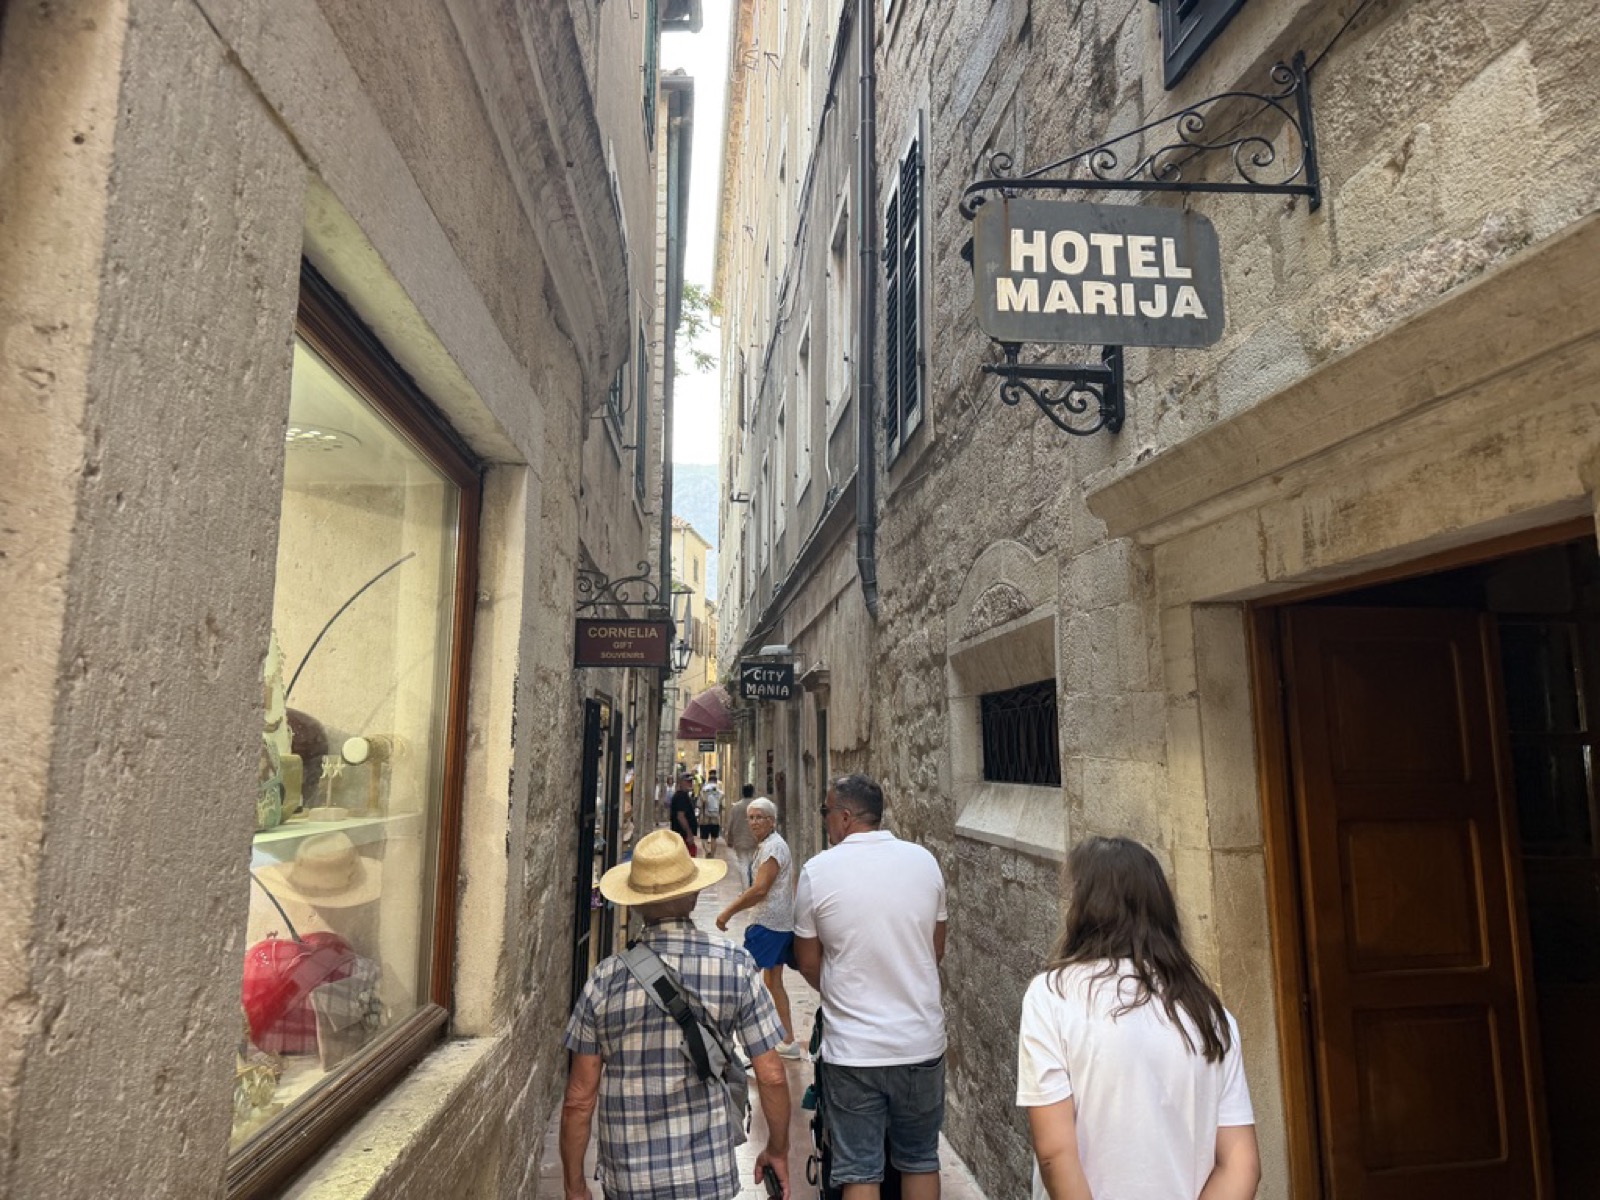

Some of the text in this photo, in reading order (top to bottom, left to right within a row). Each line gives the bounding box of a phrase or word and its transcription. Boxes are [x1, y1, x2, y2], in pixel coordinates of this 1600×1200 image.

[1010, 228, 1192, 278] HOTEL
[996, 278, 1208, 319] MARIJA
[588, 627, 659, 638] CORNELIA
[612, 641, 633, 649] GIFT
[753, 669, 785, 681] CITY
[746, 683, 790, 696] MANIA
